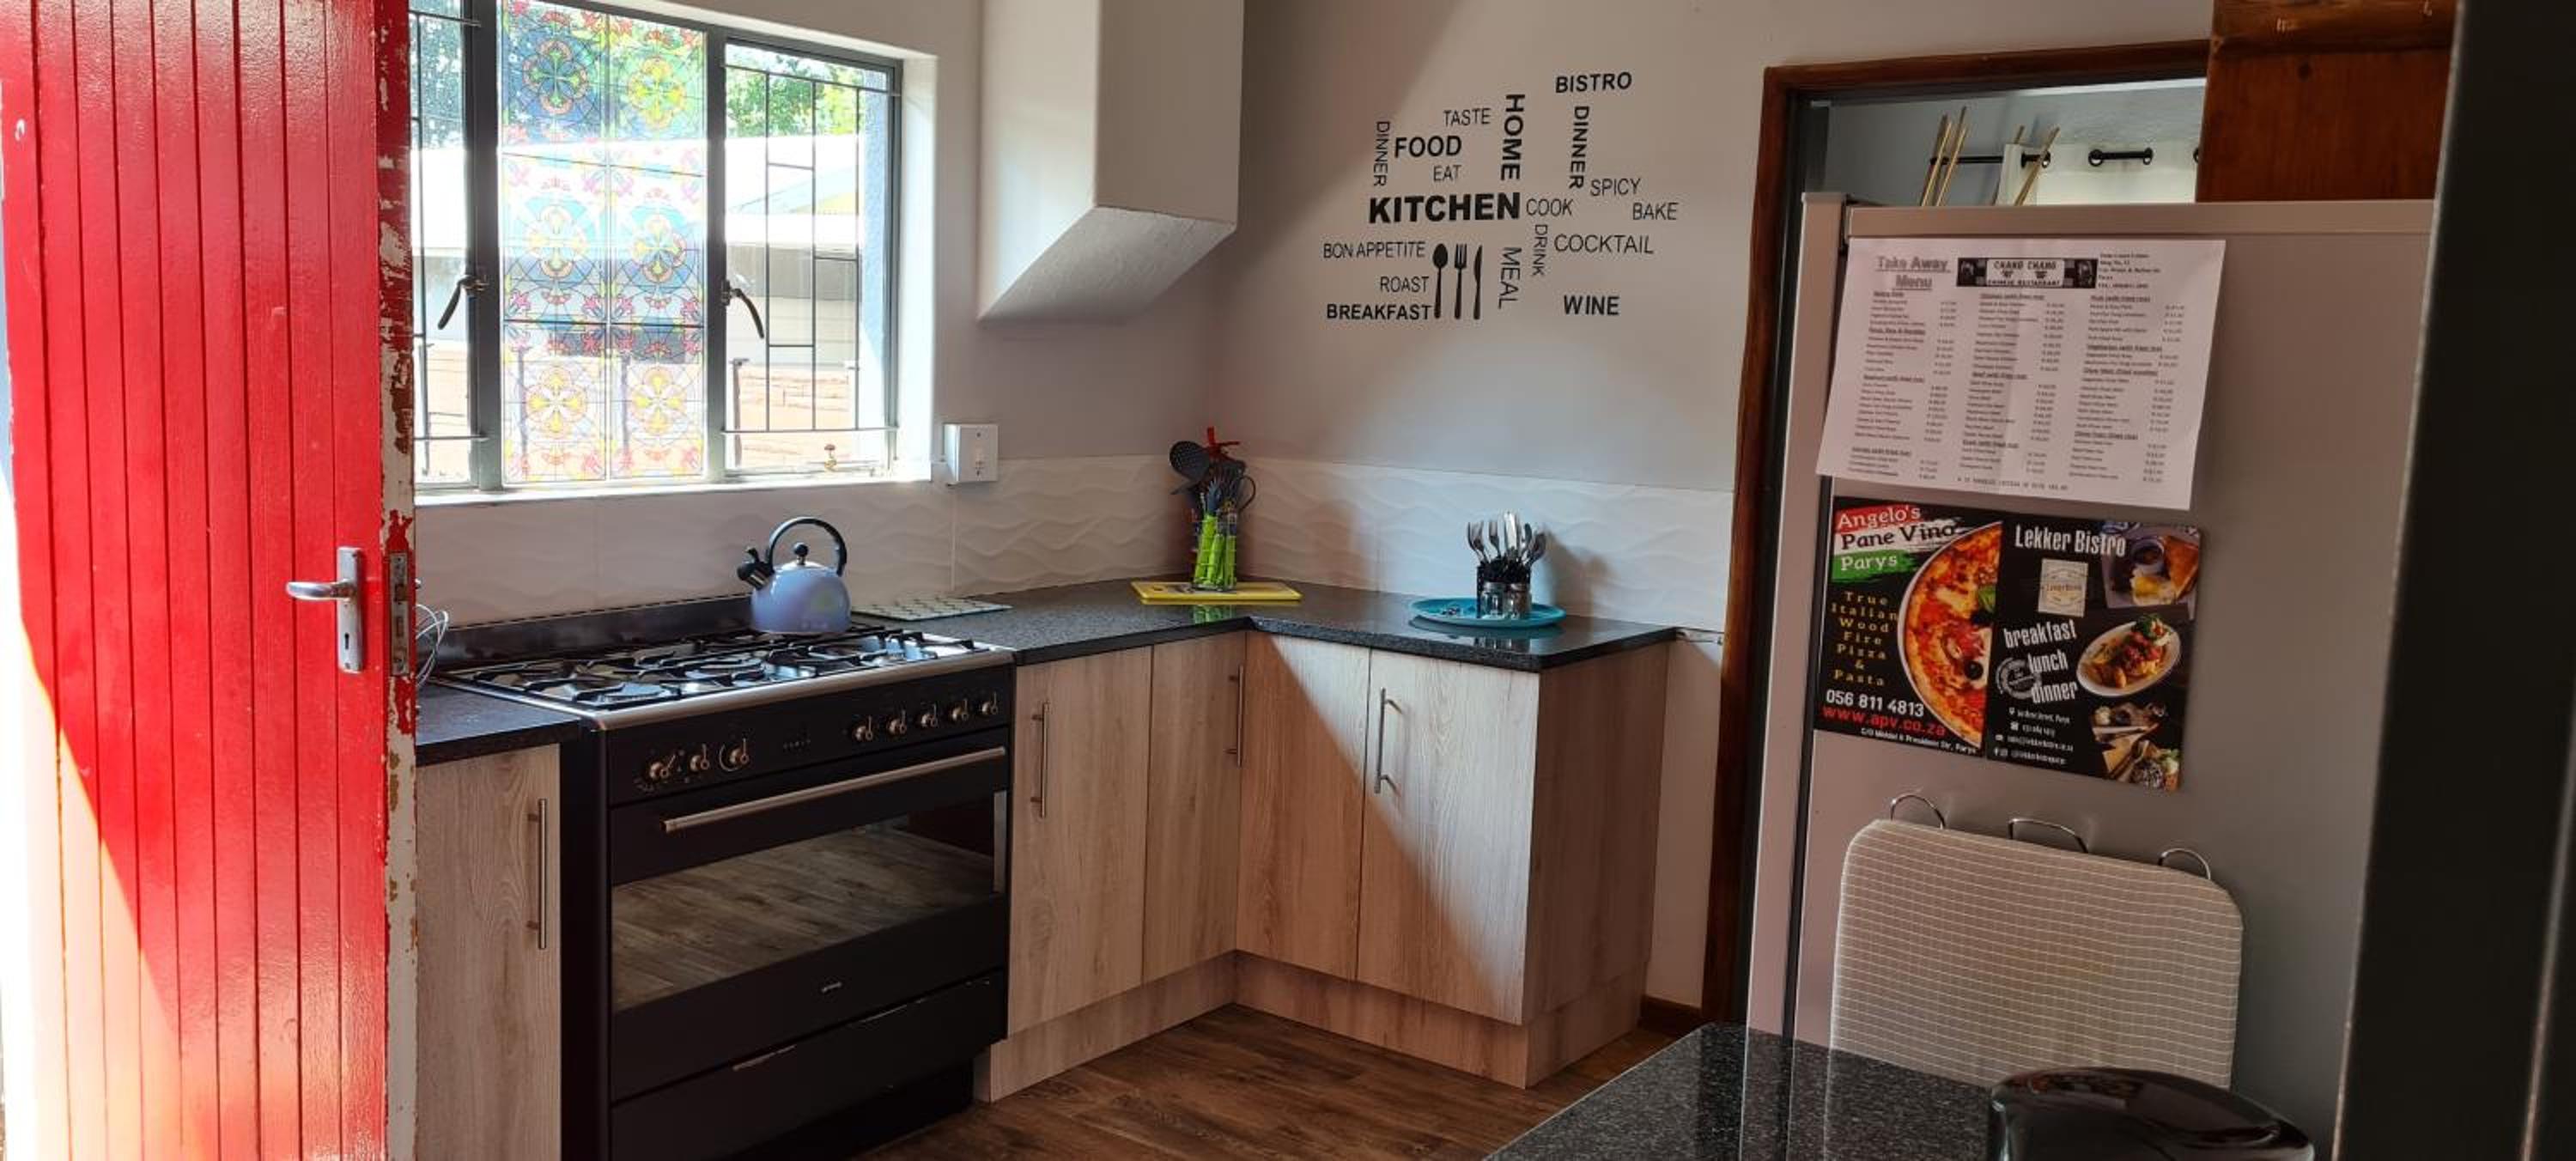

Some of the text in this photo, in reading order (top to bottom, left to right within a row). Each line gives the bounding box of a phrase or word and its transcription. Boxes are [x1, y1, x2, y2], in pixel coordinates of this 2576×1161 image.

[1556, 72, 1631, 93] BISTRO
[1443, 107, 1491, 126] TASTE
[1394, 135, 1461, 158] FOOD
[1501, 94, 1525, 180] HOME
[1374, 121, 1390, 186] DINNER
[1569, 106, 1589, 190] DINNER
[1433, 165, 1461, 182] EAT
[1590, 178, 1641, 197] SPICY
[1369, 192, 1520, 224] KITCHEN
[1526, 198, 1573, 217] COOK
[1633, 202, 1679, 220] BAKE
[1323, 240, 1425, 258] BON APPETITE
[1532, 224, 1548, 277] DRINK
[1554, 234, 1654, 254] COCKTAIL
[1877, 256, 1948, 272] Take Away
[1380, 276, 1429, 293] ROAST
[1498, 247, 1522, 309] MEAL
[1895, 275, 1932, 288] Menu
[1327, 303, 1431, 320] BREAKFAST
[1564, 295, 1619, 316] WINE
[1838, 505, 1921, 528] Angelo's
[1842, 523, 1955, 550] Pane Vino
[2014, 524, 2126, 557] Lekker Bistro
[1840, 555, 1897, 571] Parys
[1845, 592, 1888, 605] True
[1831, 602, 1898, 621] Italian
[1840, 617, 1889, 633] Wood
[2003, 619, 2077, 648] breakfast
[1843, 631, 1882, 645] Fire
[1837, 644, 1886, 660] Pizza
[2027, 648, 2069, 673] lunch
[1854, 660, 1865, 671] &
[1833, 669, 1885, 686] Pasta
[2031, 681, 2078, 704] dinner
[1826, 689, 1924, 717] 056 811 4813
[1822, 705, 1947, 736] www.apv.co.za
